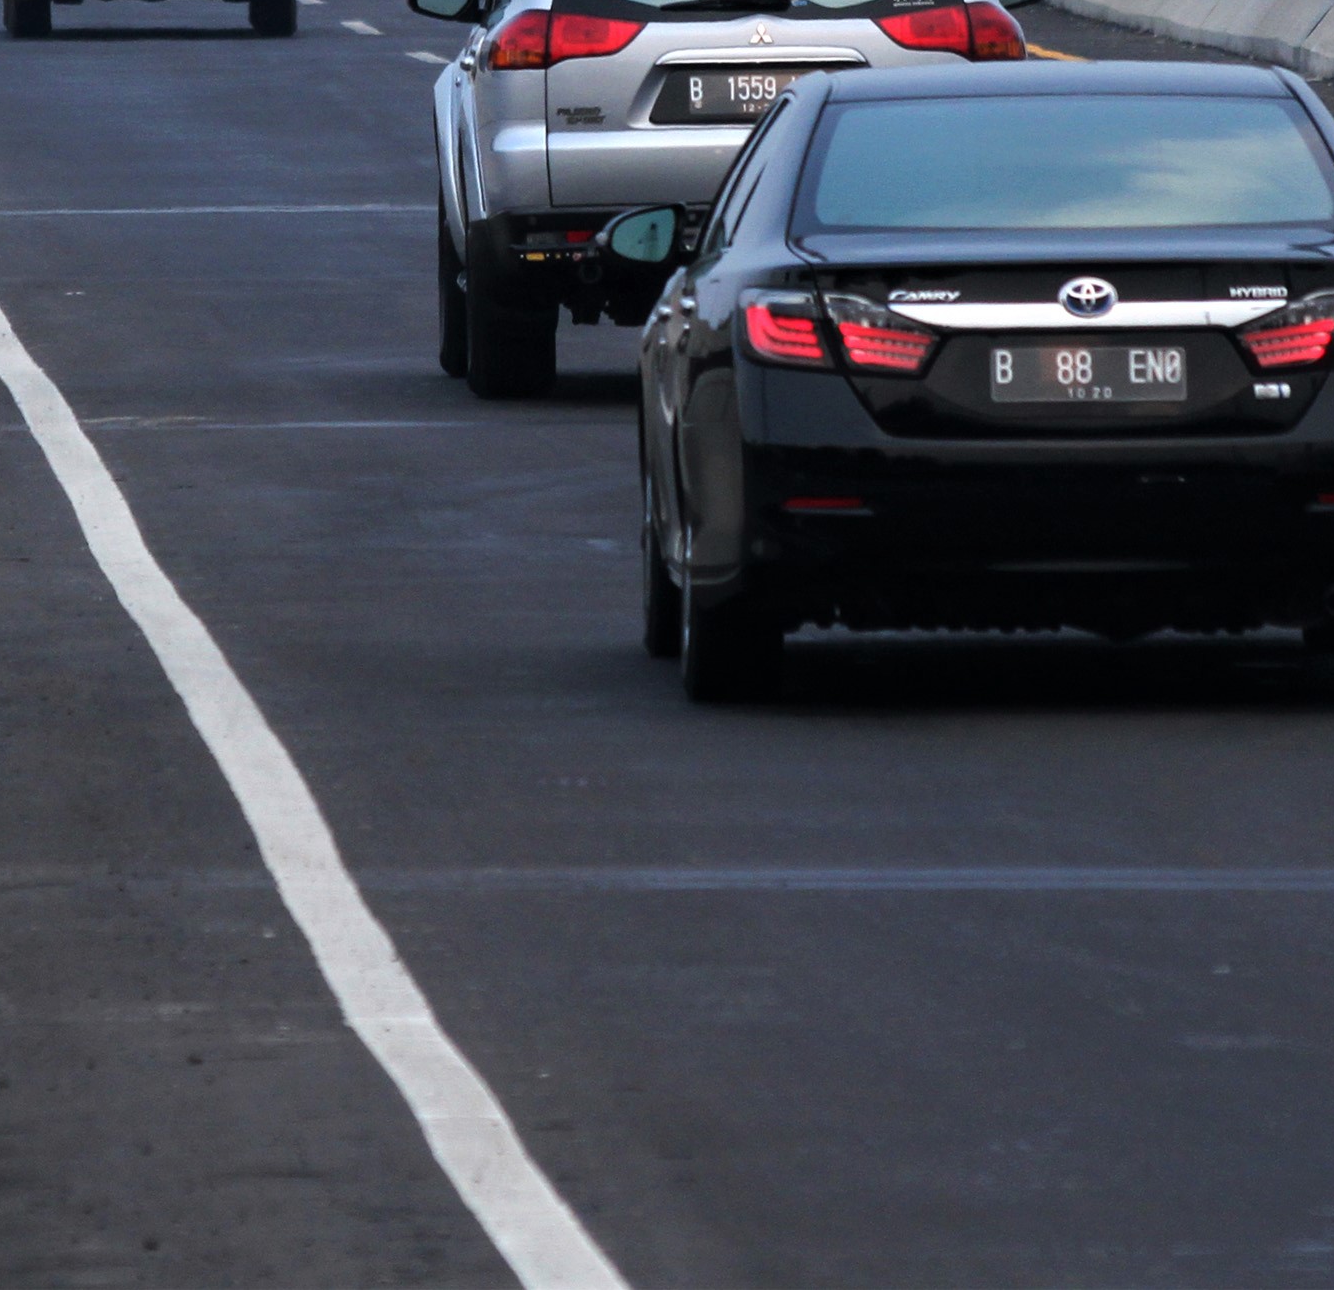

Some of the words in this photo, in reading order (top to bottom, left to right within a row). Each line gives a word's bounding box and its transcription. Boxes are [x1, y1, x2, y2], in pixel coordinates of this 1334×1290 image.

[690, 76, 703, 101] B
[728, 76, 776, 101] 1559
[1229, 286, 1288, 298] HYBRID
[996, 350, 1013, 384] B
[1057, 350, 1092, 384] 88
